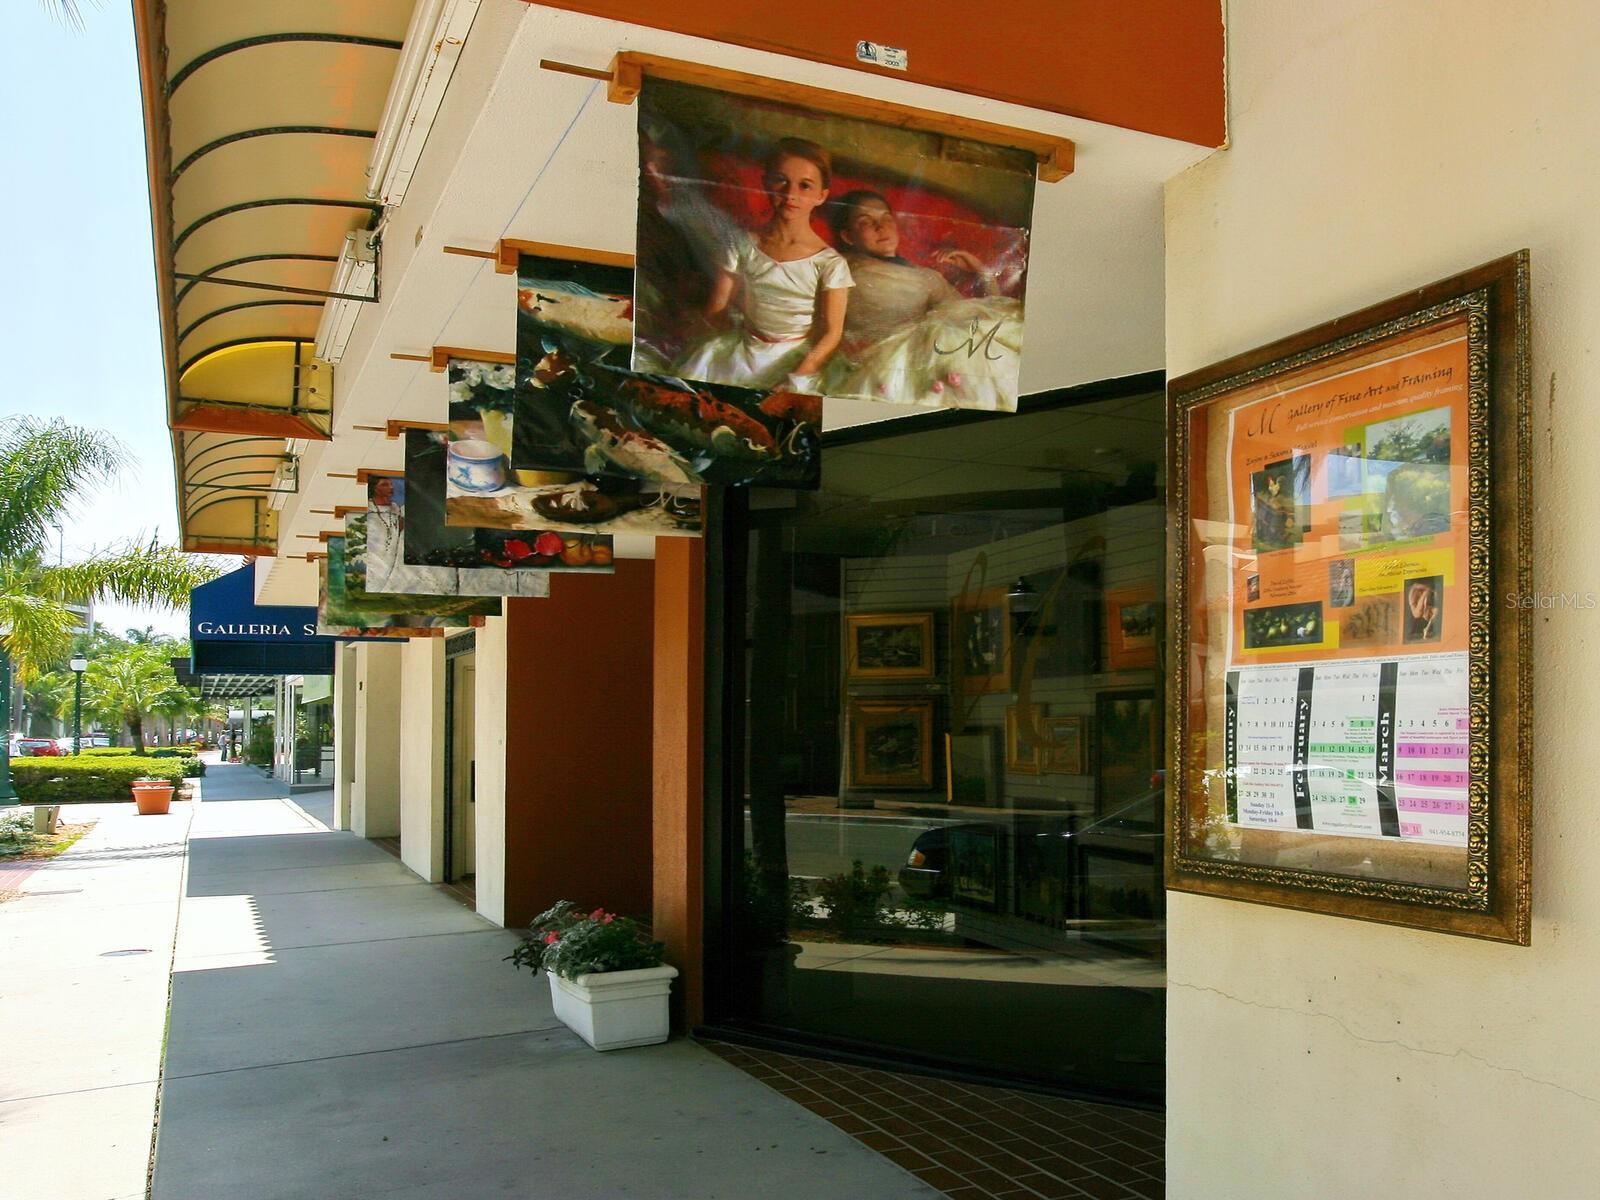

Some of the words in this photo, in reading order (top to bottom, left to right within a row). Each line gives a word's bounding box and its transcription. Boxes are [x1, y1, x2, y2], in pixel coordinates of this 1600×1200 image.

[1288, 401, 1324, 423] Gallery
[1325, 394, 1337, 415] of
[1338, 391, 1362, 404] Fine
[1364, 384, 1384, 398] Art
[1385, 382, 1400, 393] and
[1401, 367, 1453, 388] Framing
[197, 622, 292, 634] GALLERIA
[1296, 698, 1308, 798] February
[1378, 712, 1390, 786] March
